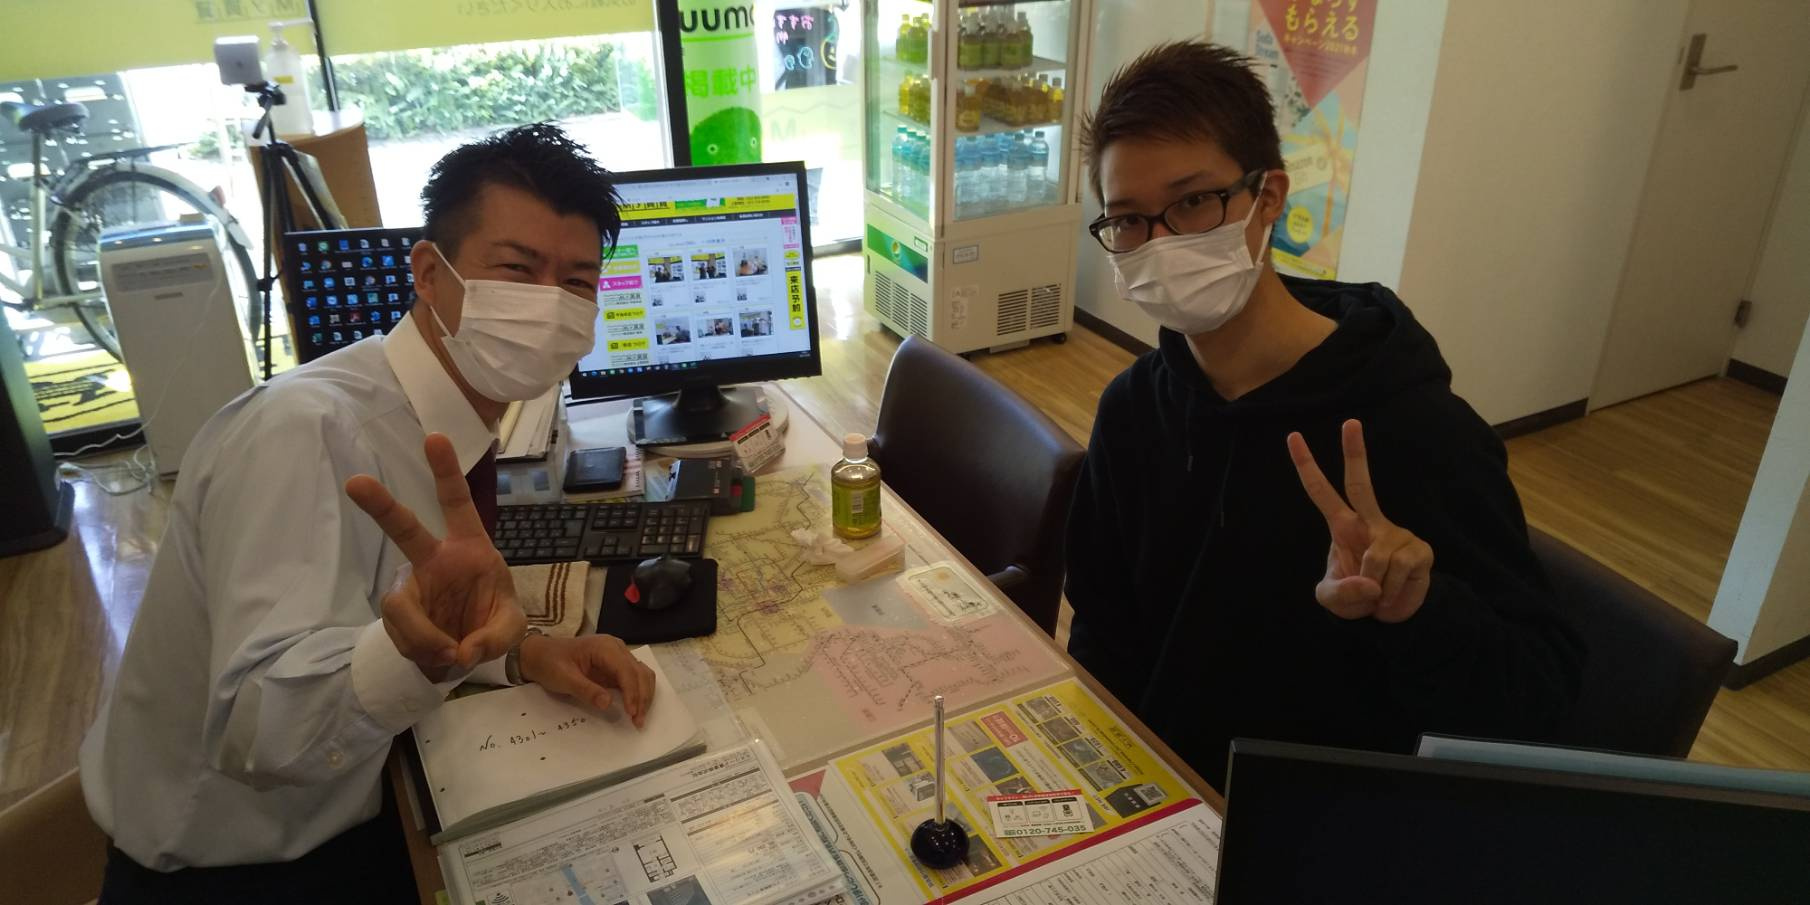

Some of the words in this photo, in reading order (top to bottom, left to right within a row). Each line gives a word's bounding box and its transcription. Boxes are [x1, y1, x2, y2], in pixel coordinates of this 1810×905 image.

[1285, 4, 1360, 41] もらえる
[789, 276, 802, 312] 来店予約
[1015, 824, 1088, 836] 0120-745-035
